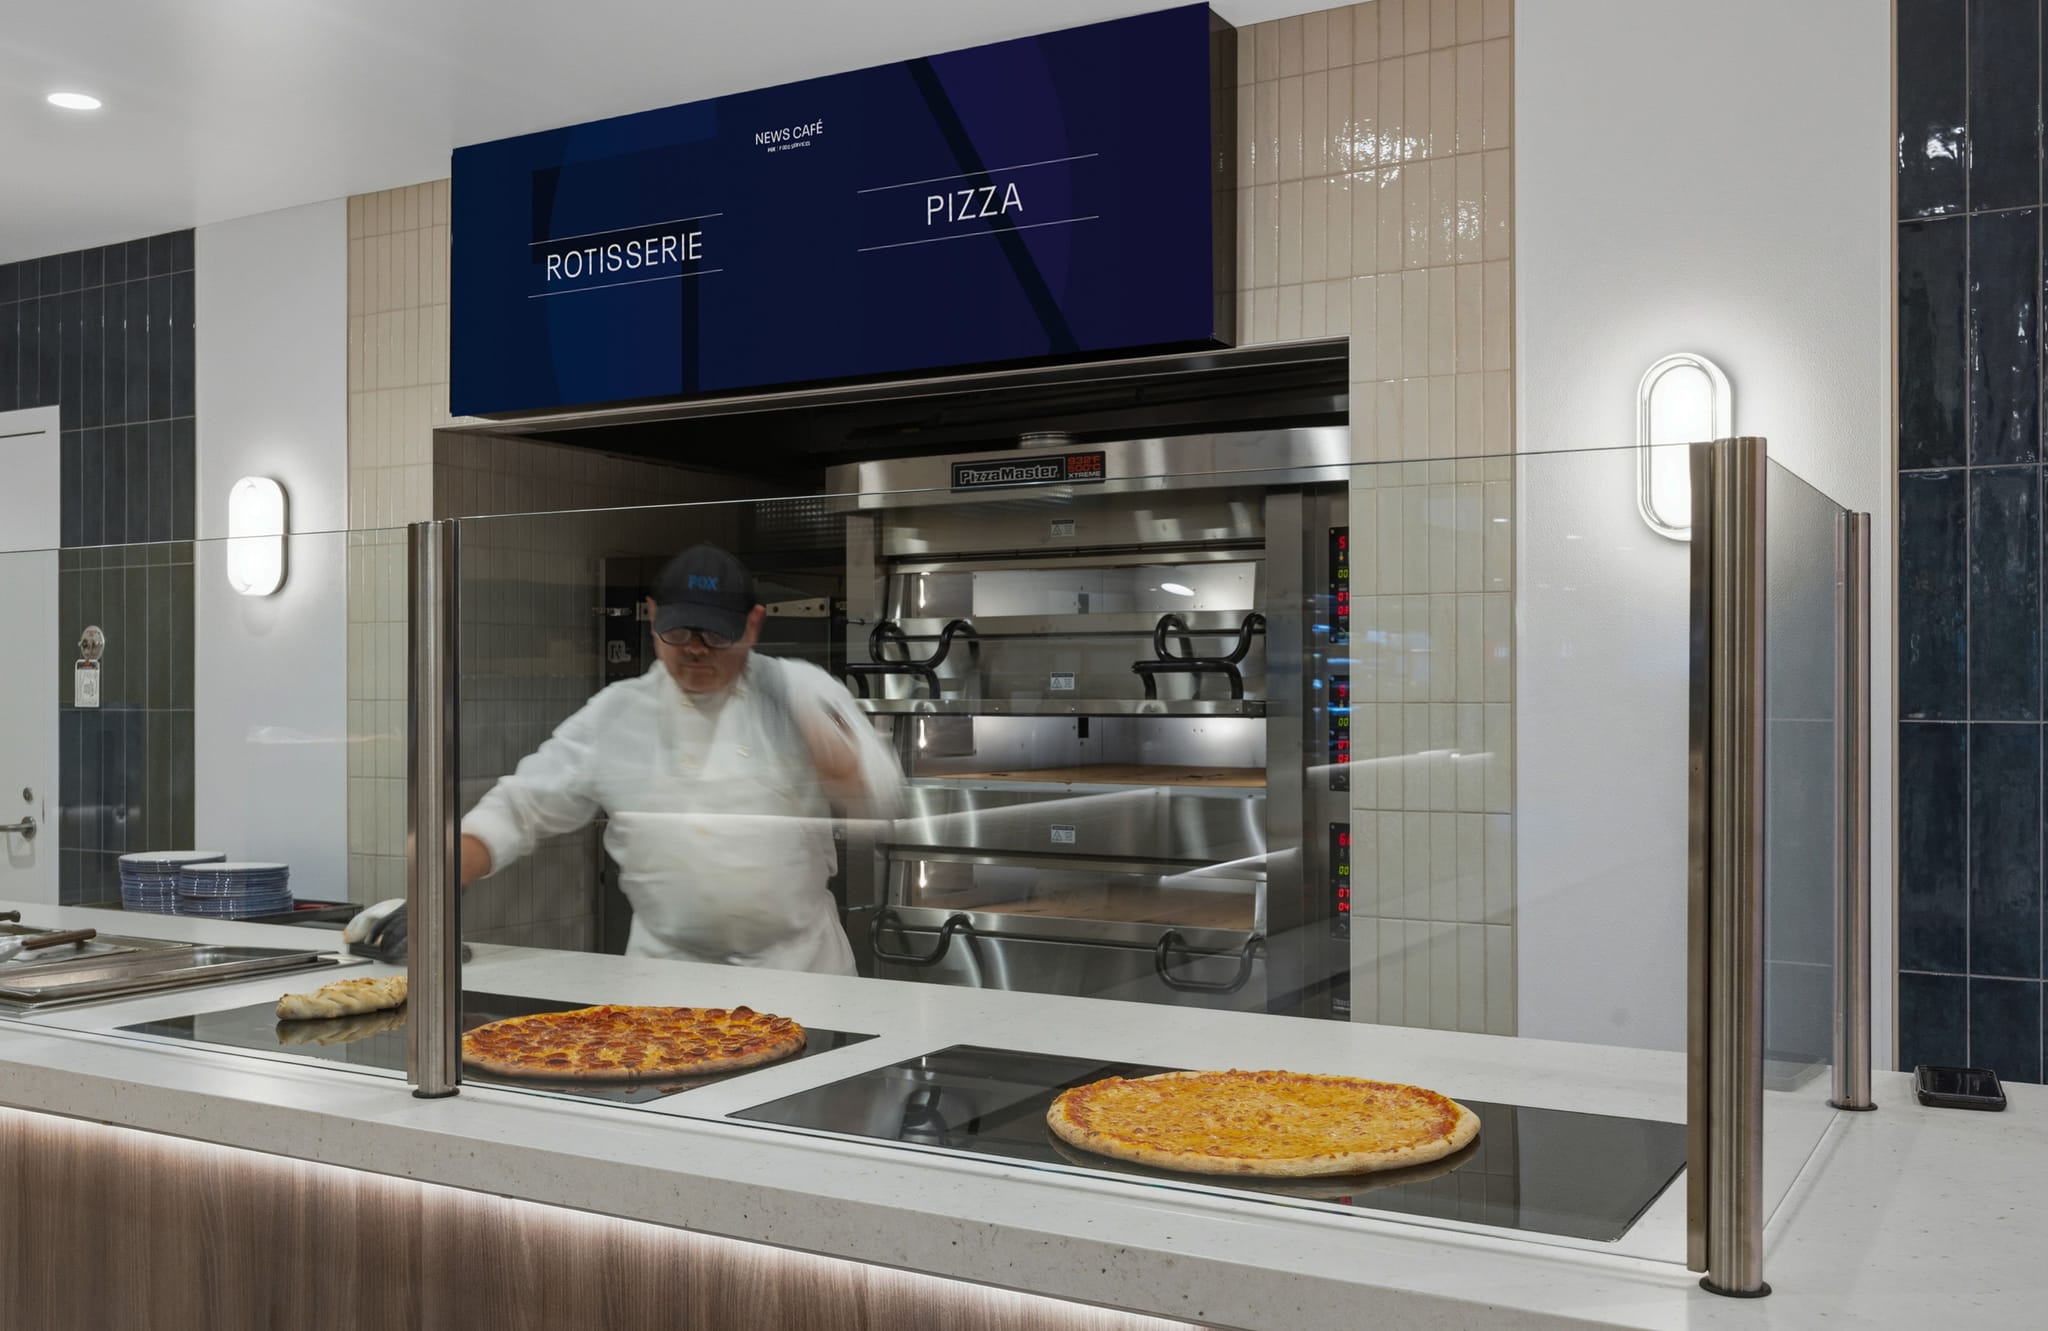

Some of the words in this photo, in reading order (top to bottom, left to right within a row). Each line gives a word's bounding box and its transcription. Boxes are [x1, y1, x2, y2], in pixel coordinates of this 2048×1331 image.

[755, 128, 790, 145] NEWS
[792, 118, 823, 139] CAFÉ
[927, 183, 1023, 225] PIZZA
[547, 232, 703, 281] ROTISSERIE
[960, 465, 1058, 485] PizzaMaster
[687, 575, 719, 591] FOX
